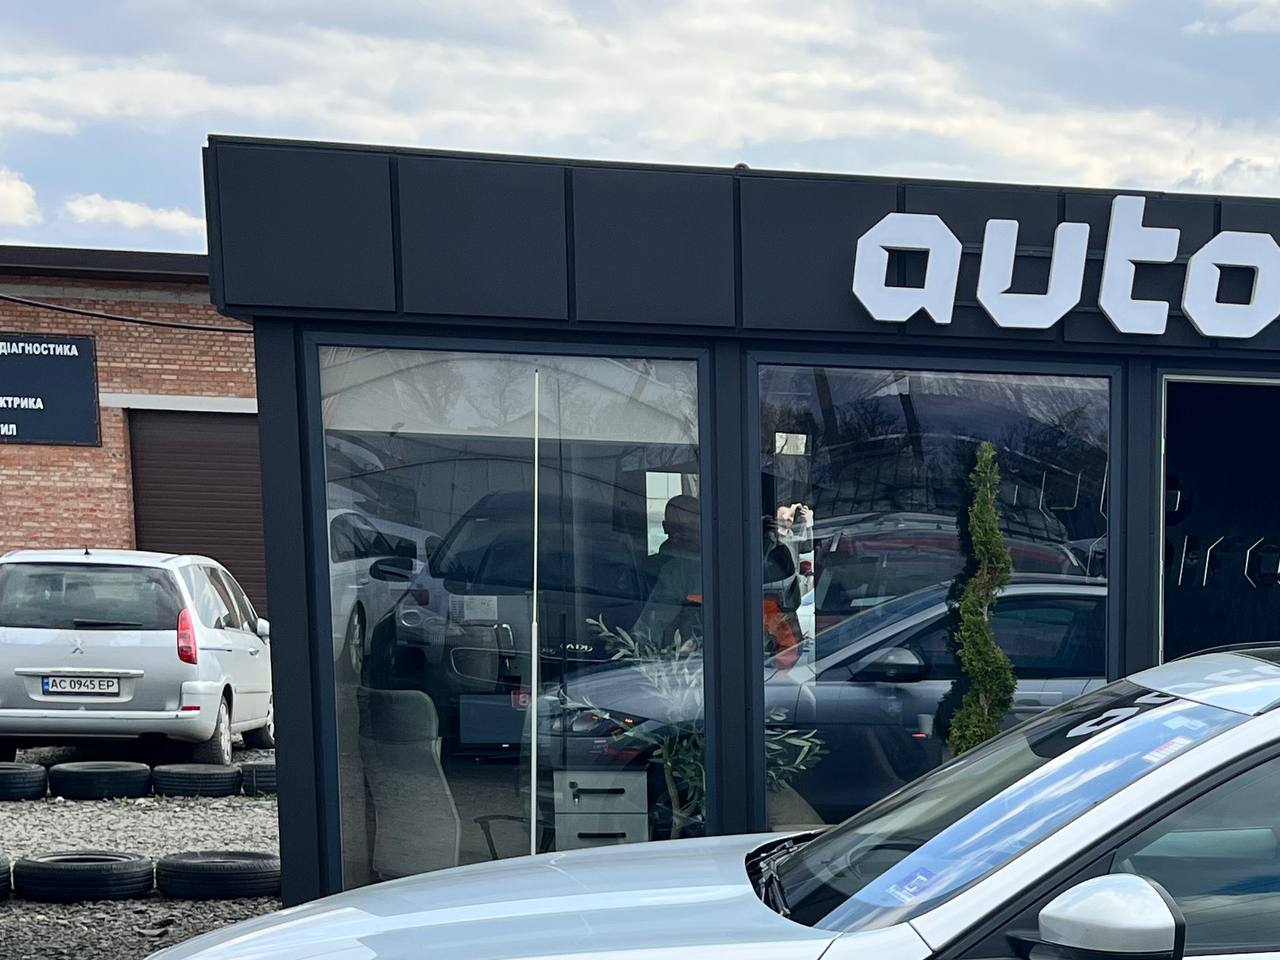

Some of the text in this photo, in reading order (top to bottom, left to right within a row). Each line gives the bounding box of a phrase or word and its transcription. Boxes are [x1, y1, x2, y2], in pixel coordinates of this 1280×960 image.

[0, 342, 79, 356] ДІАГНОСТИКА
[0, 423, 17, 436] ИЛ
[51, 679, 114, 691] AC 0945 EP
